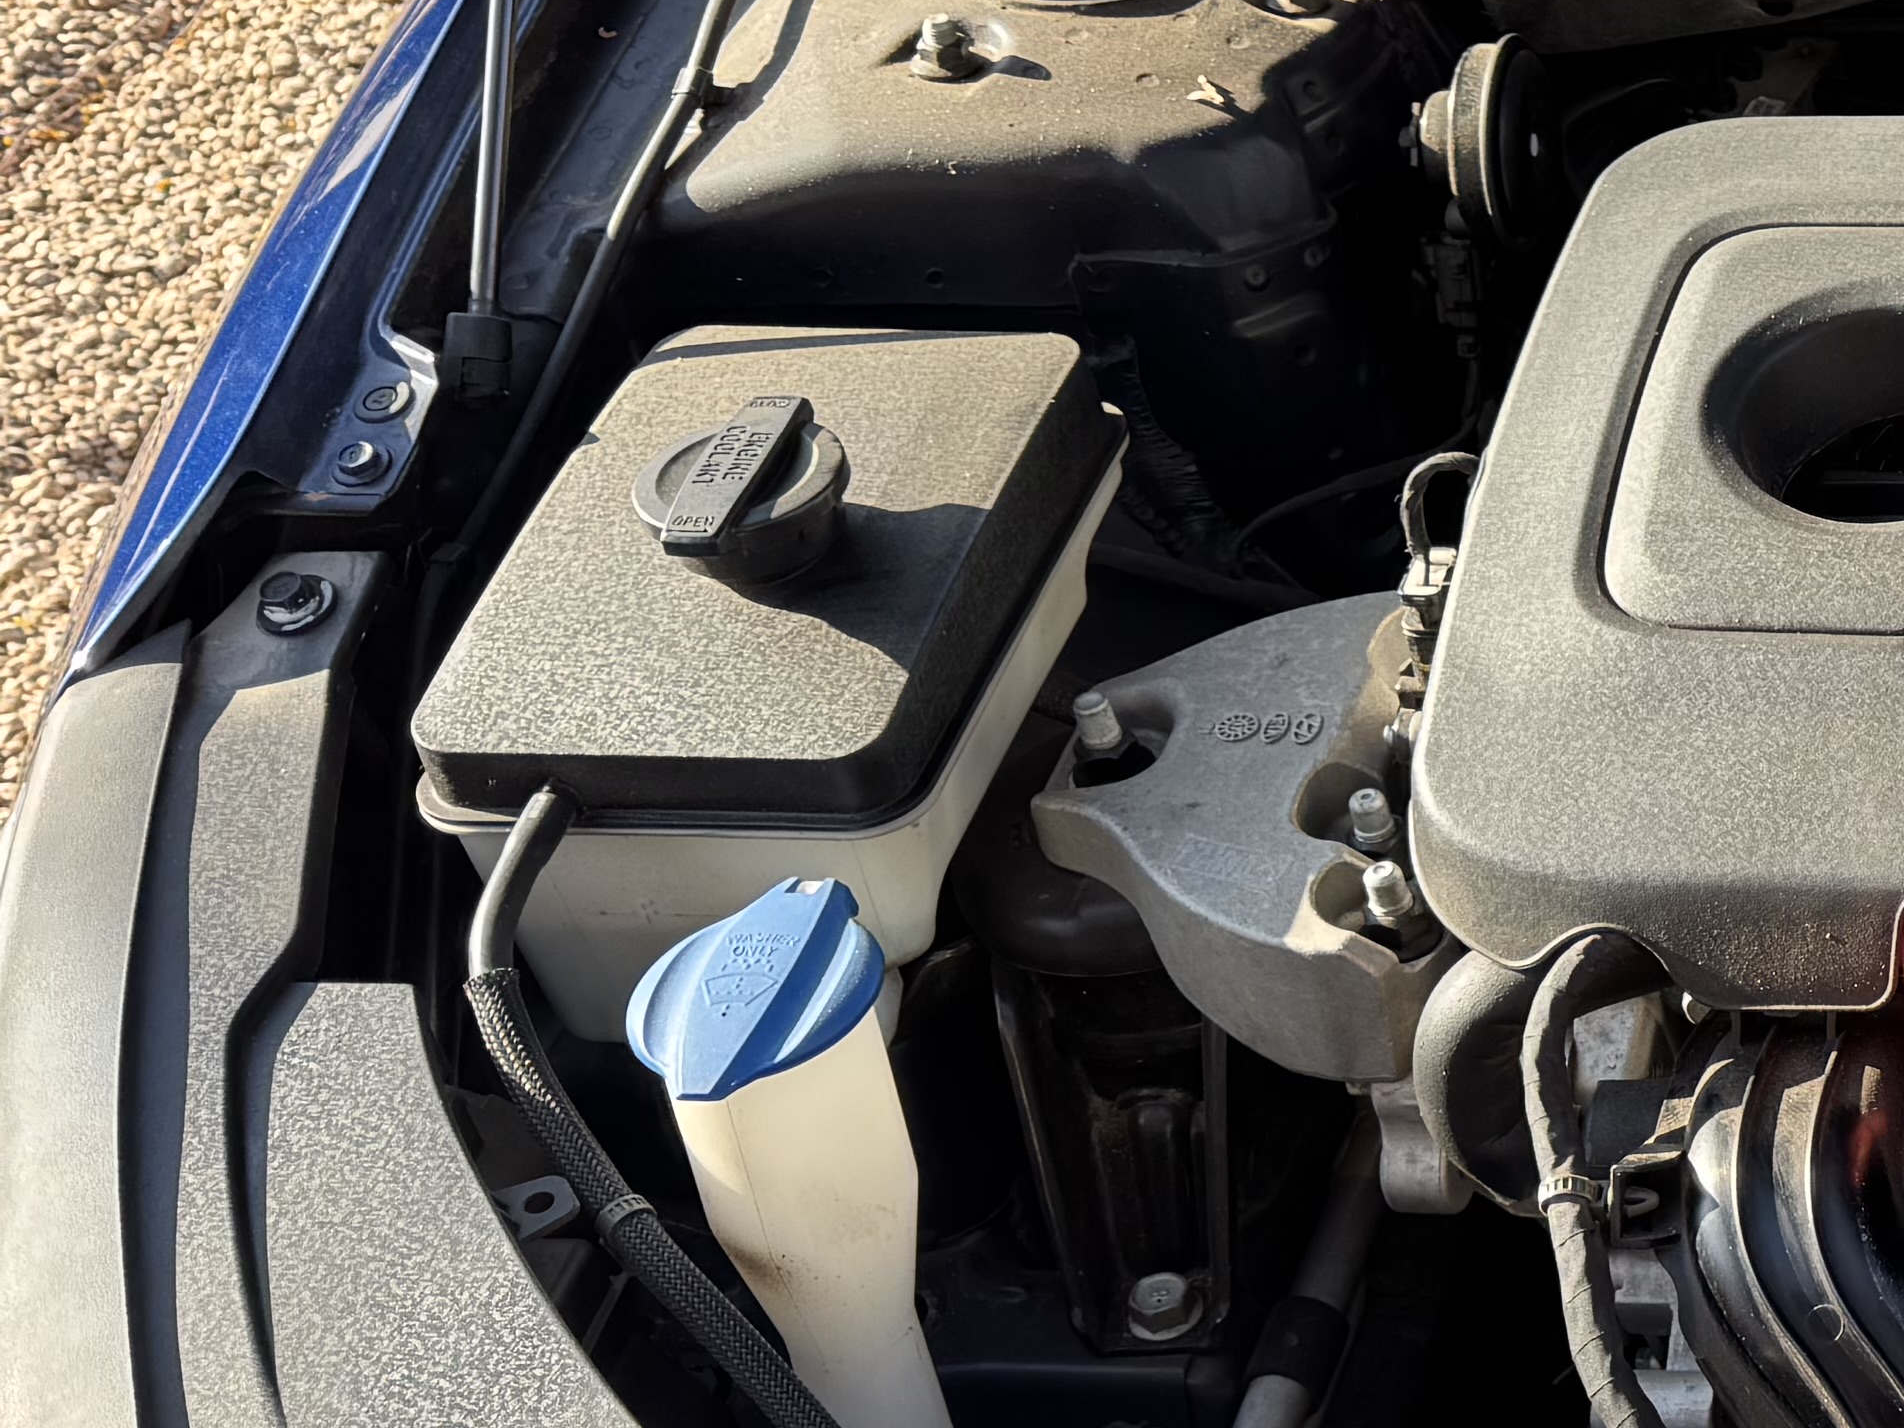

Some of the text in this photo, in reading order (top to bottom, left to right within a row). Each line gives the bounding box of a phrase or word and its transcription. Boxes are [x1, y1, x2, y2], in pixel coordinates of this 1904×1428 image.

[671, 515, 715, 527] OPEN
[726, 932, 801, 947] WASHER
[732, 945, 779, 958] ONLY
